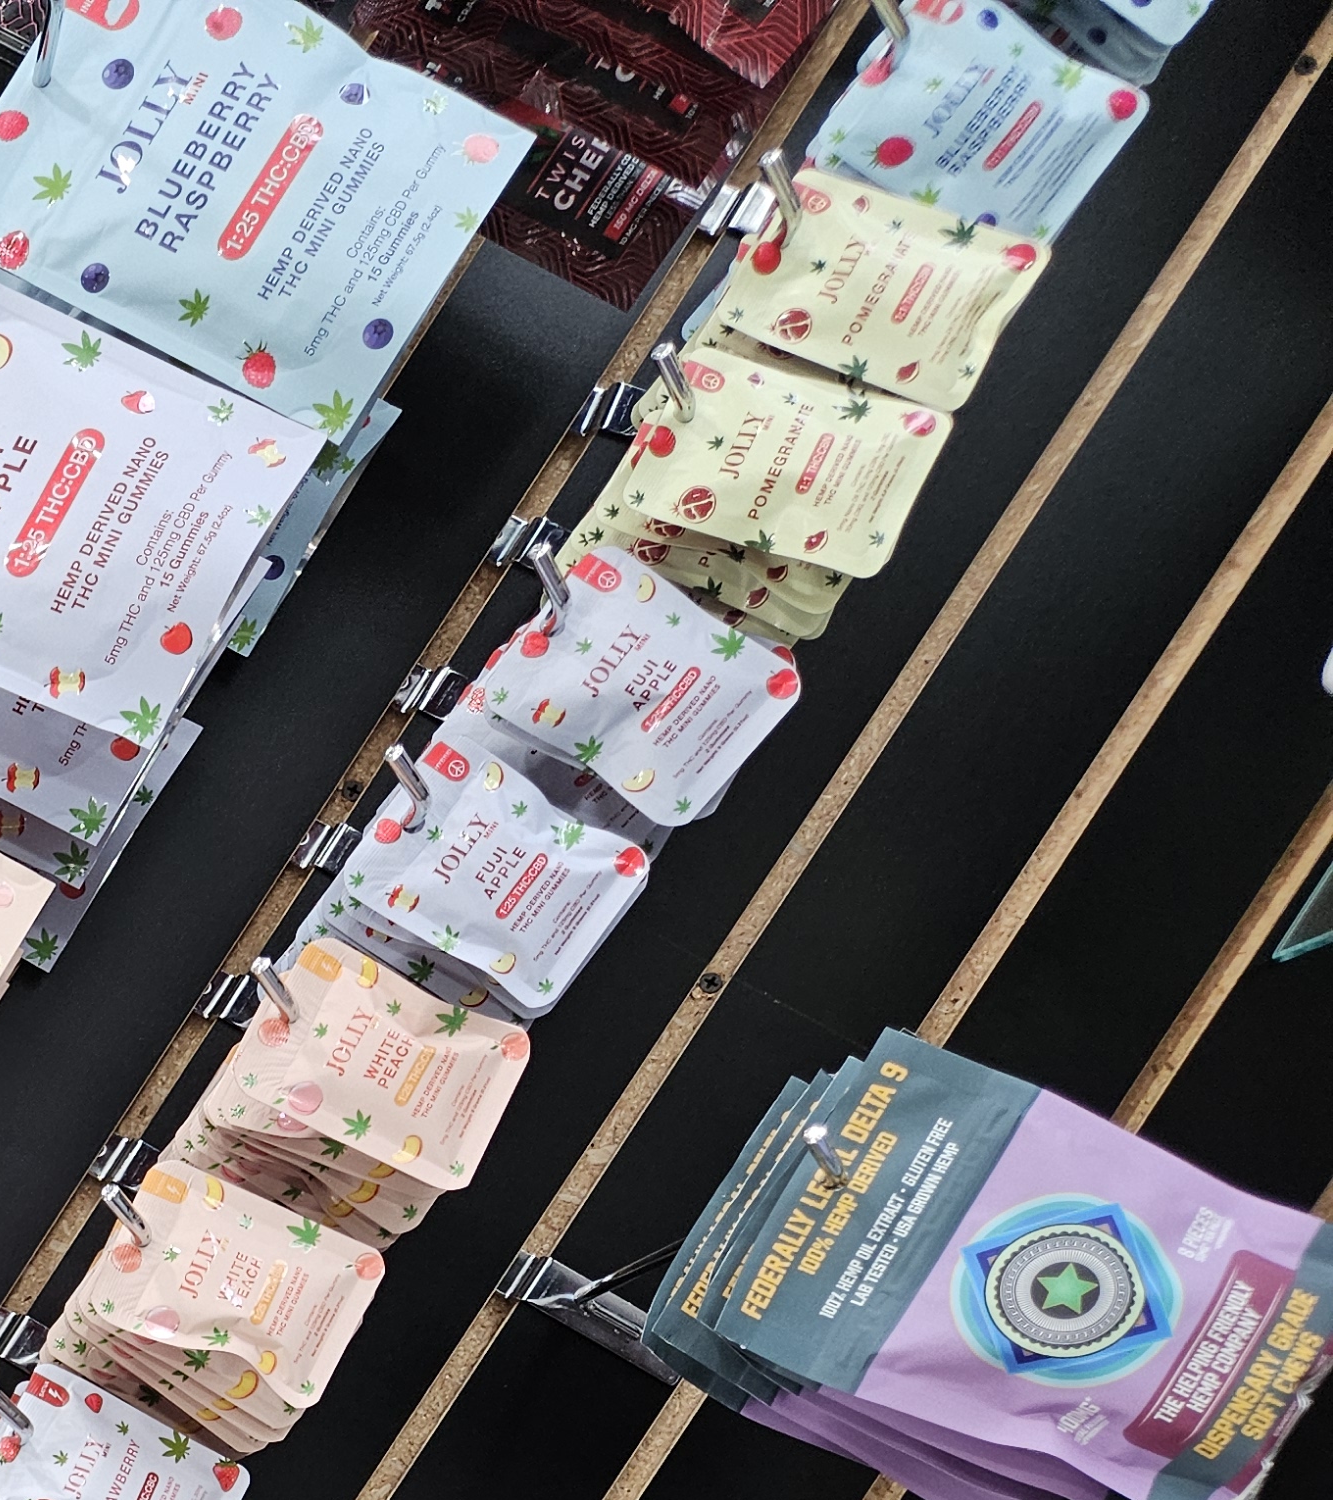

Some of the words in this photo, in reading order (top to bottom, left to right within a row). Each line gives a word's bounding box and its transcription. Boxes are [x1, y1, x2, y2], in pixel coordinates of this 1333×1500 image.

[92, 58, 196, 196] JOLLY
[134, 58, 259, 242] BLUEBERRY
[158, 70, 284, 255] RASPBERRY
[223, 206, 262, 255] 1:25
[249, 118, 318, 212] THC:CBD
[12, 525, 49, 571] 1:25
[35, 431, 100, 530] THC:CBD
[747, 401, 815, 521] POMEGRANATE
[159, 571, 175, 589] 15
[168, 507, 212, 572] Gummies
[474, 844, 508, 884] FUJI
[481, 845, 527, 900] APPLE
